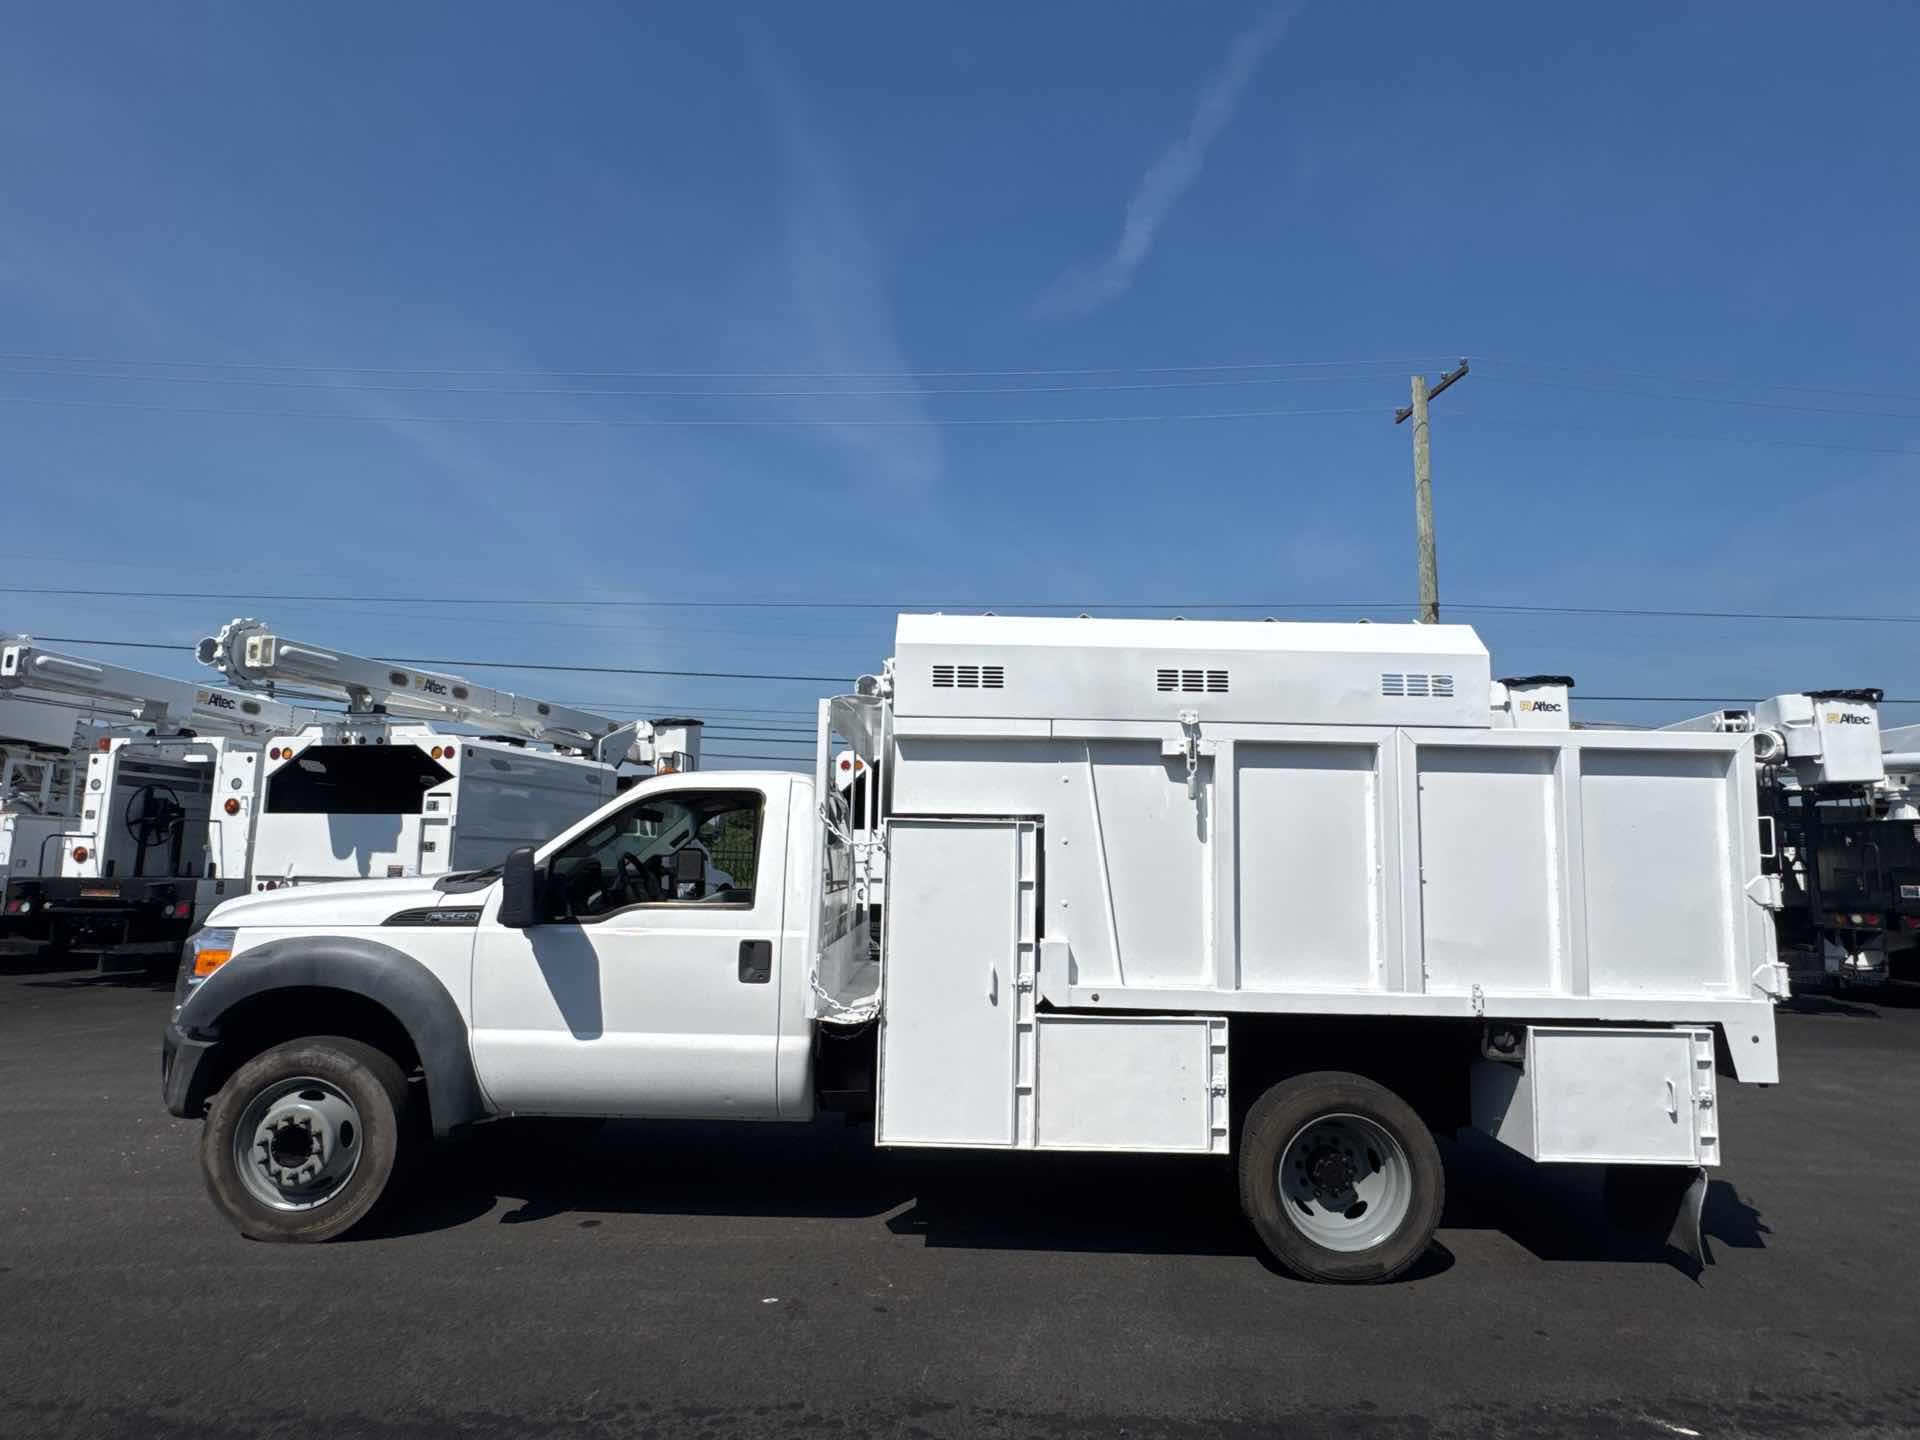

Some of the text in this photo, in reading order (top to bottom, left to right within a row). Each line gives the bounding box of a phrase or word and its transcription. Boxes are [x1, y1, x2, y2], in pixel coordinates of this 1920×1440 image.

[424, 679, 447, 696] Altec
[208, 693, 236, 710] Altec
[1532, 701, 1562, 712] Altec
[1840, 713, 1871, 724] Altec
